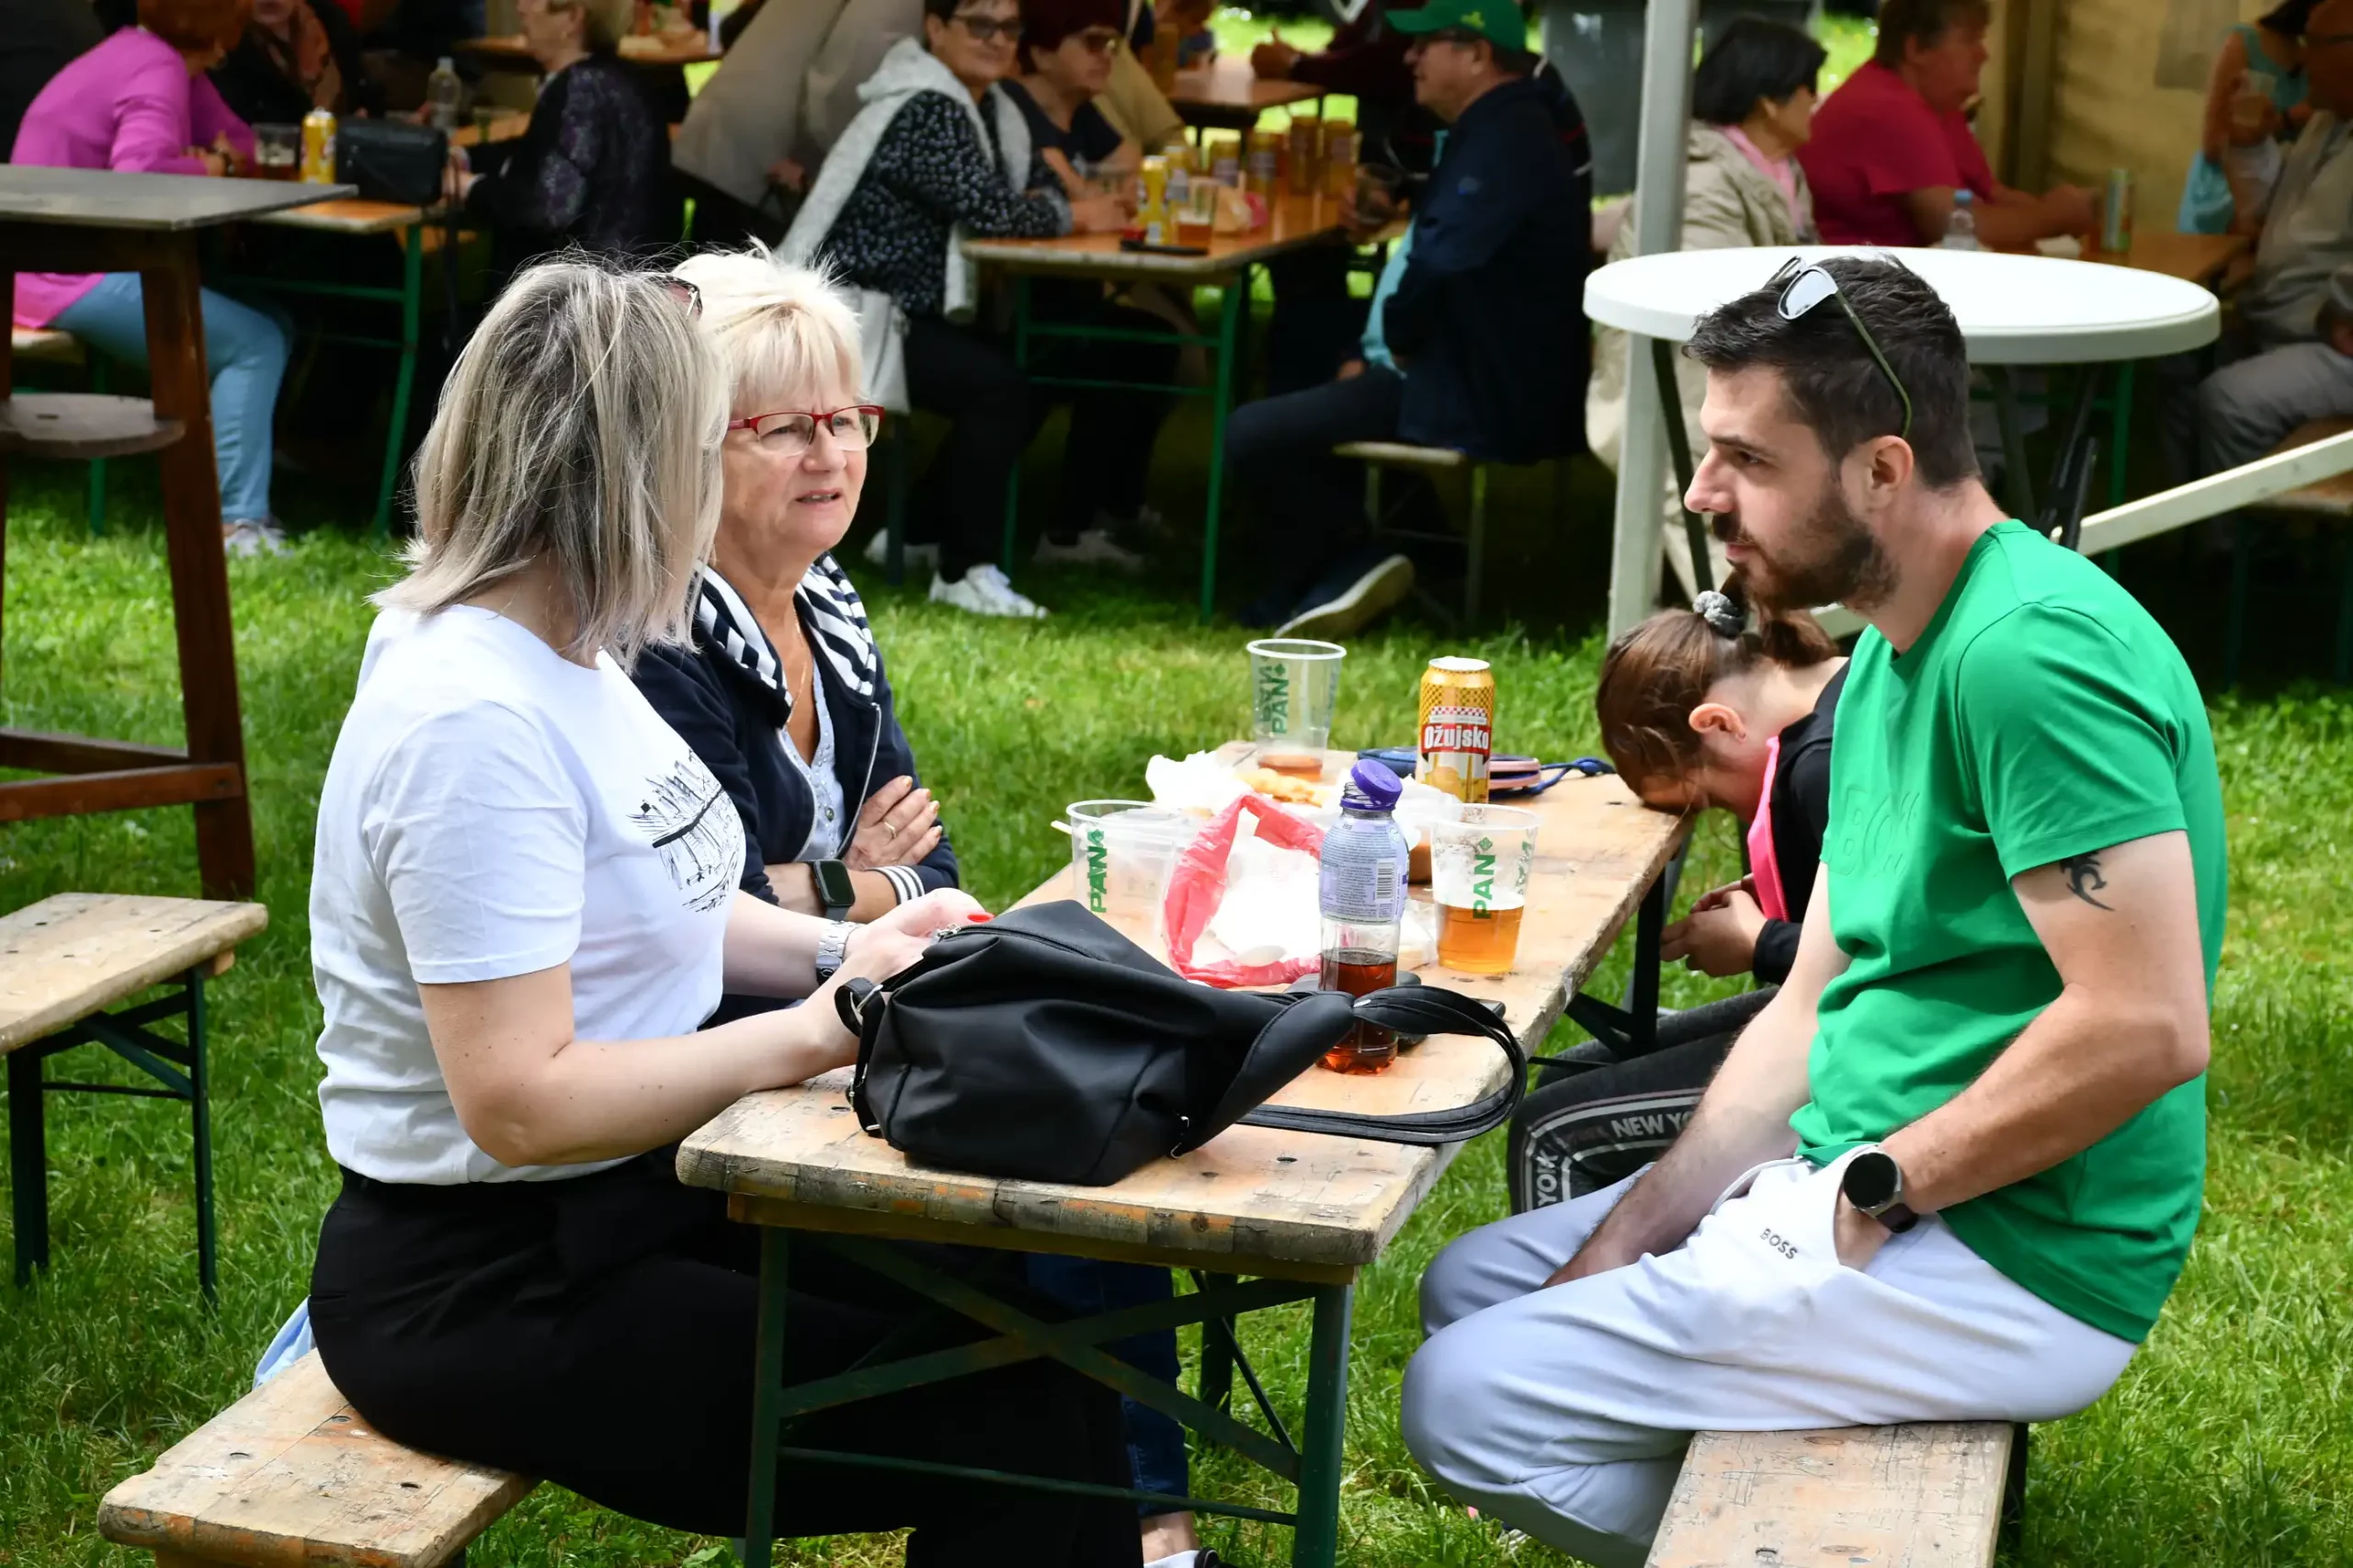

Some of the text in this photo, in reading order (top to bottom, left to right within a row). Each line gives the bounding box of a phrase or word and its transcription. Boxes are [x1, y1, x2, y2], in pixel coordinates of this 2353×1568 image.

[1272, 678, 1289, 733] PAN
[1424, 724, 1490, 751] Ožujsko
[1088, 846, 1108, 913] PAN
[1472, 854, 1496, 919] PAN
[1610, 1113, 1665, 1139] NEW
[1759, 1228, 1799, 1260] BOSS
